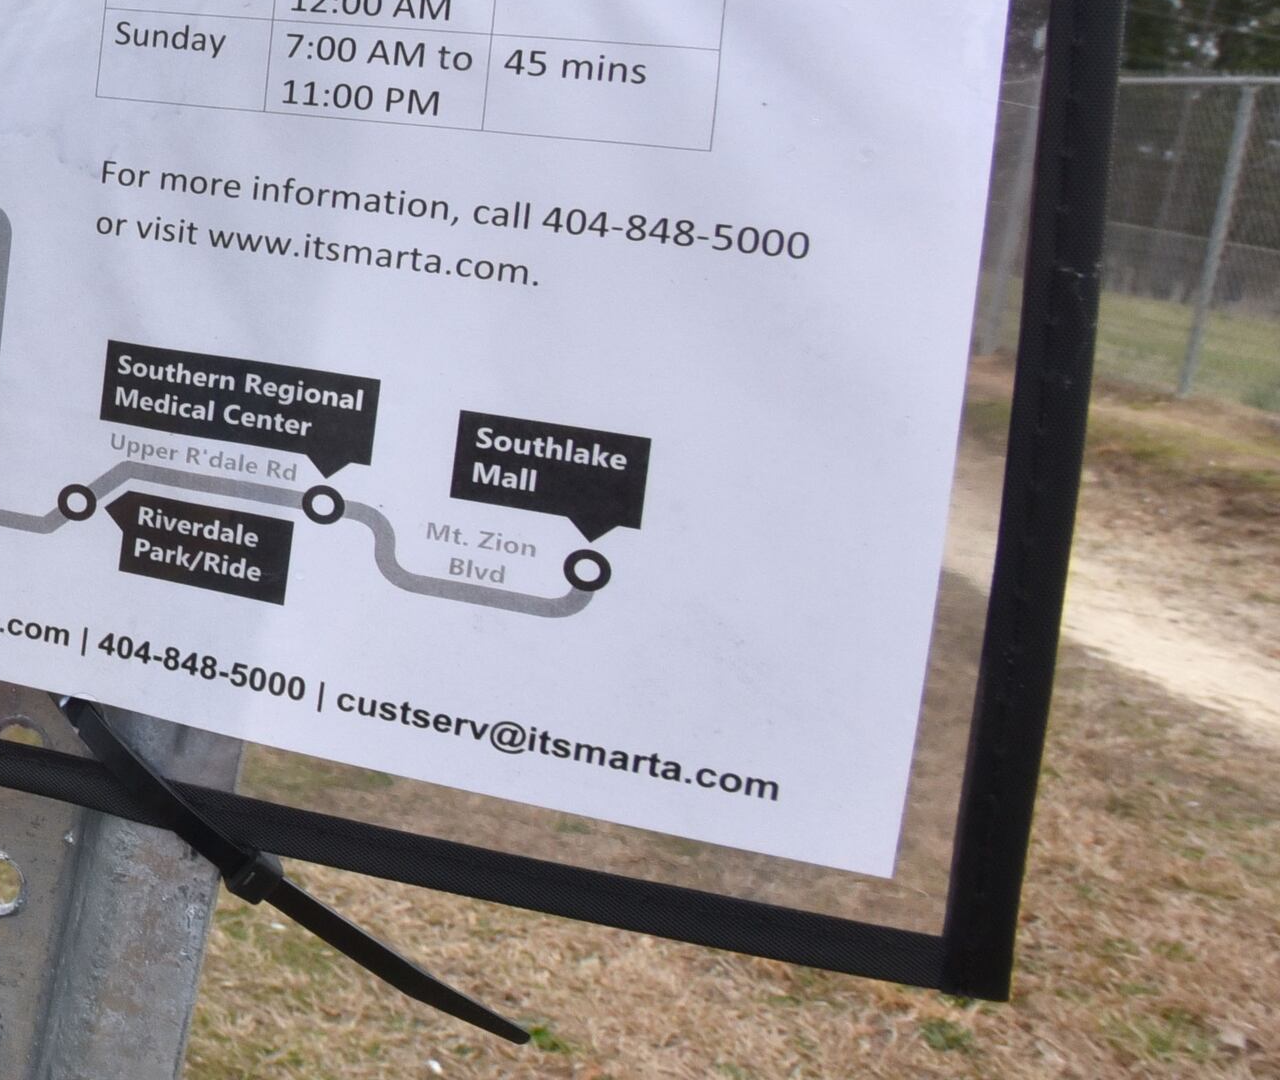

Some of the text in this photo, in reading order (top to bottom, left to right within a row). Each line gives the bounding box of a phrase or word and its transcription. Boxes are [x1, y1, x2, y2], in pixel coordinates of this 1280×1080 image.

[114, 21, 227, 58] Sunday
[285, 34, 473, 72] 7:00 AM to
[504, 49, 647, 85] 45 mins
[282, 80, 440, 116] 11:00 PM
[101, 160, 809, 260] For more information, call 404-848-5000
[96, 214, 539, 287] or visit www.itsmarta.com.
[117, 354, 364, 412] Southern Regional
[114, 385, 312, 437] Medical Center
[110, 432, 297, 482] Upper R'dale Rd
[476, 426, 628, 472] Southlake
[471, 461, 537, 493] Mall
[137, 506, 259, 548] Riverdale
[425, 521, 537, 558] Mt. Zion
[133, 537, 262, 583] Park/Ride
[448, 556, 505, 584] Blvd
[97, 631, 305, 702] 404-848-5000
[336, 687, 780, 802] custserv@itsmarta.com
